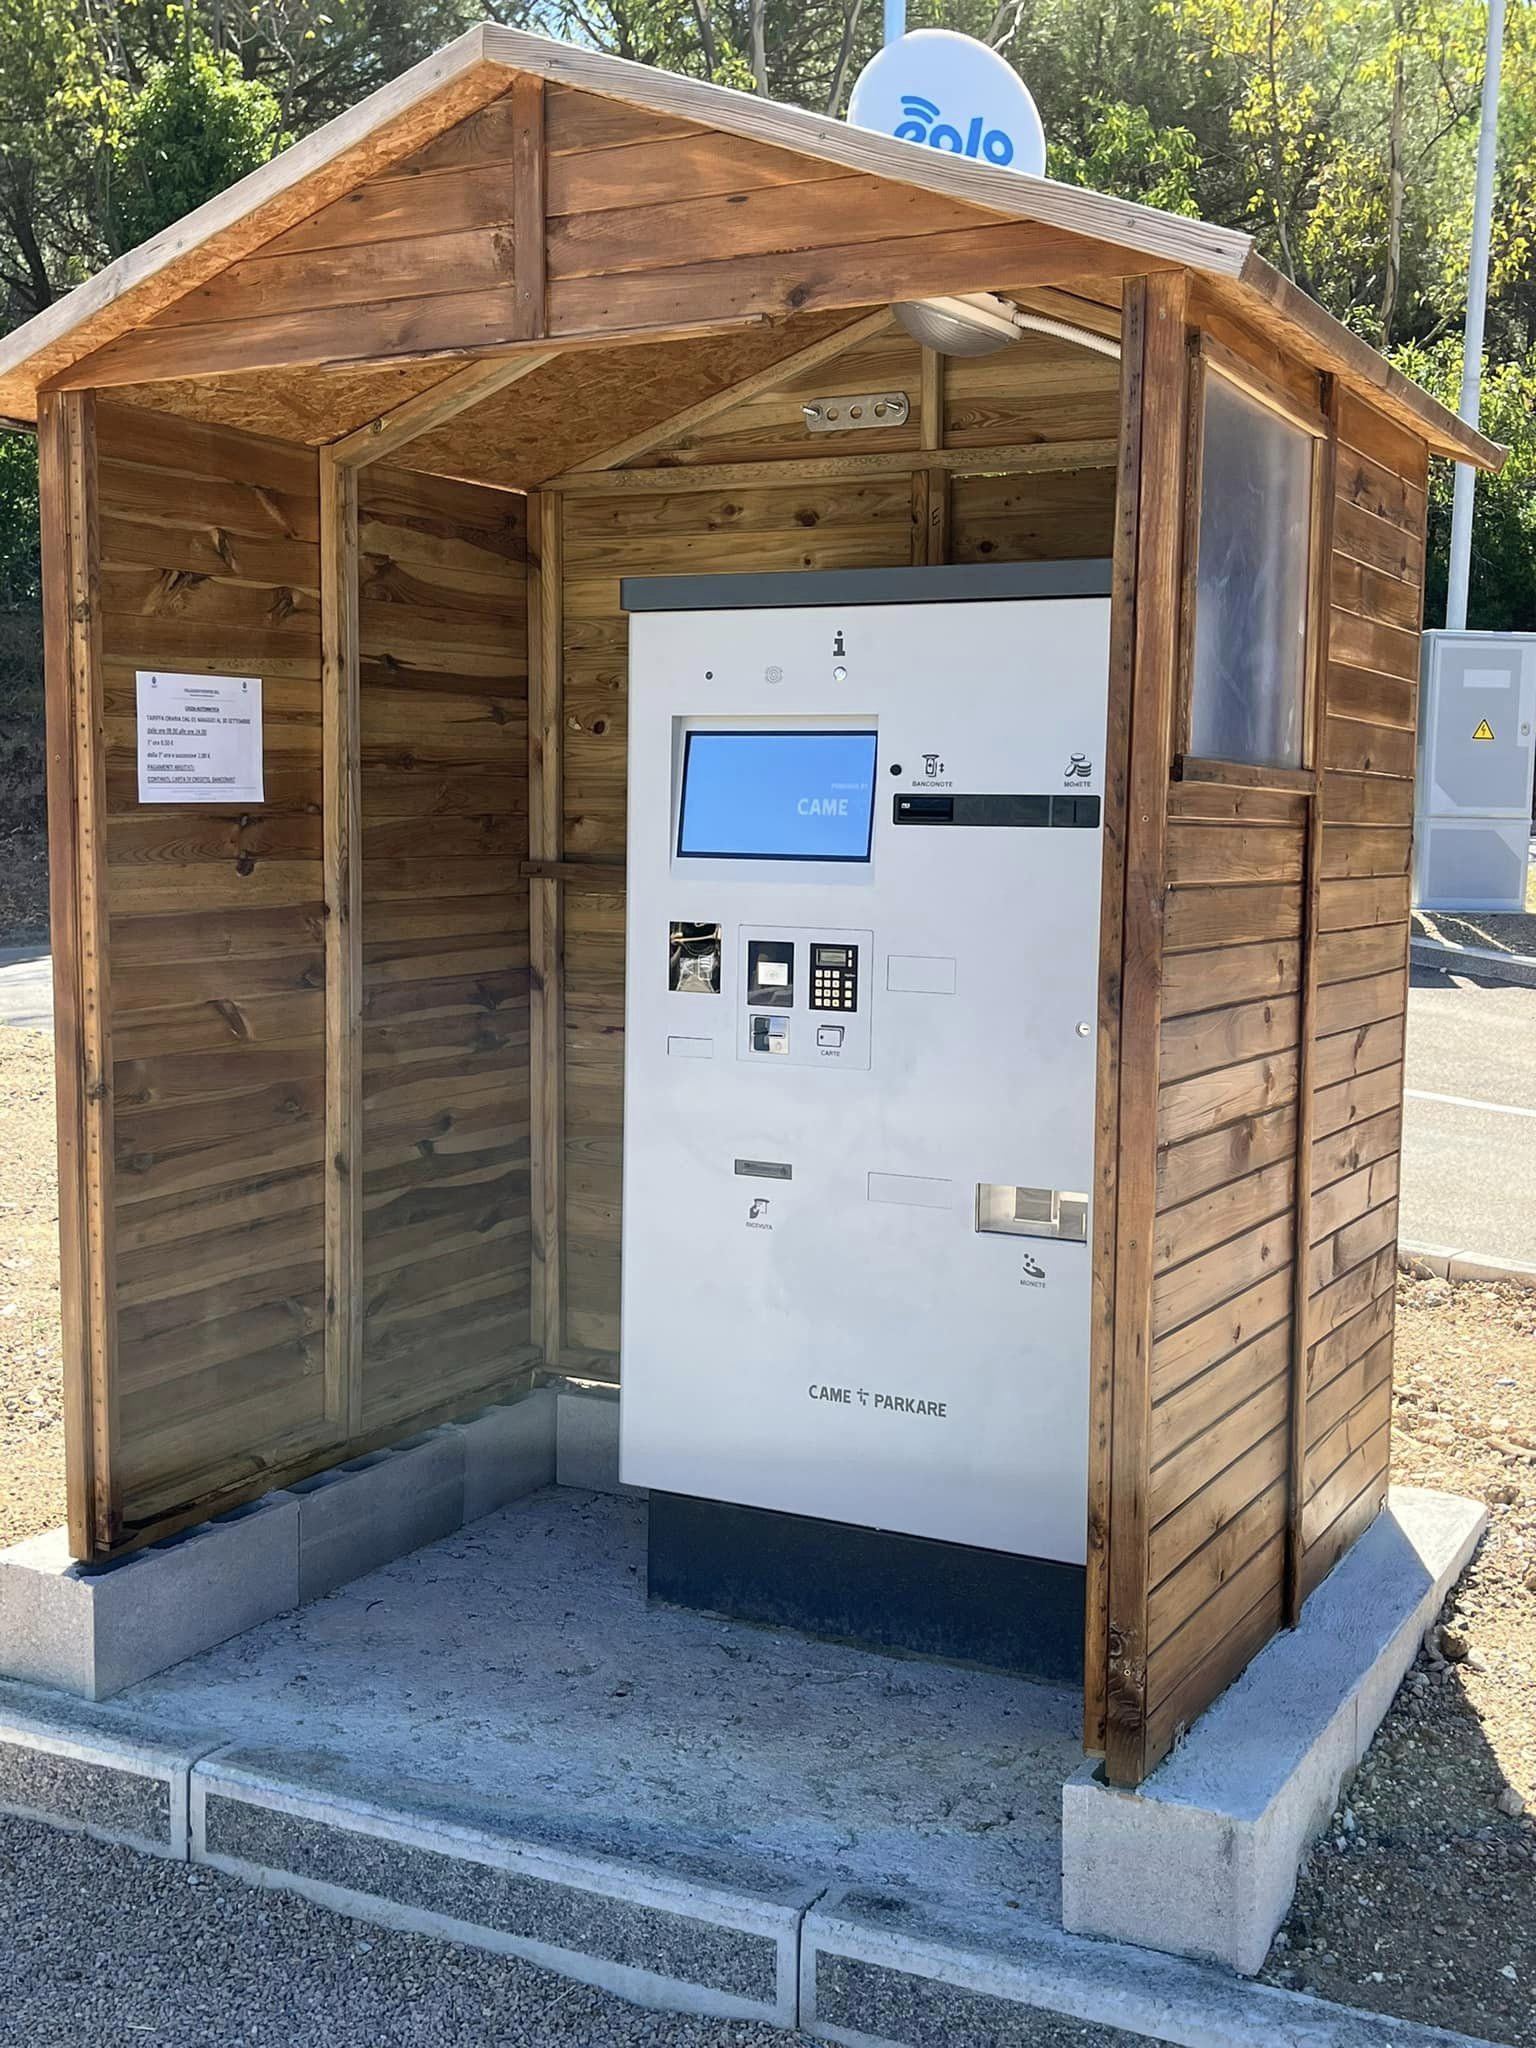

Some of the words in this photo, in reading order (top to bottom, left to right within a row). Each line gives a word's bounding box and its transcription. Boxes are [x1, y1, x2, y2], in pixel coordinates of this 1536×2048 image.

[1063, 780, 1091, 788] MONETE
[797, 798, 849, 816] CAME
[820, 1049, 841, 1057] CARTE
[1020, 1279, 1046, 1289] MONETE
[808, 1384, 852, 1404] CAME
[874, 1393, 947, 1418] PARKARE
